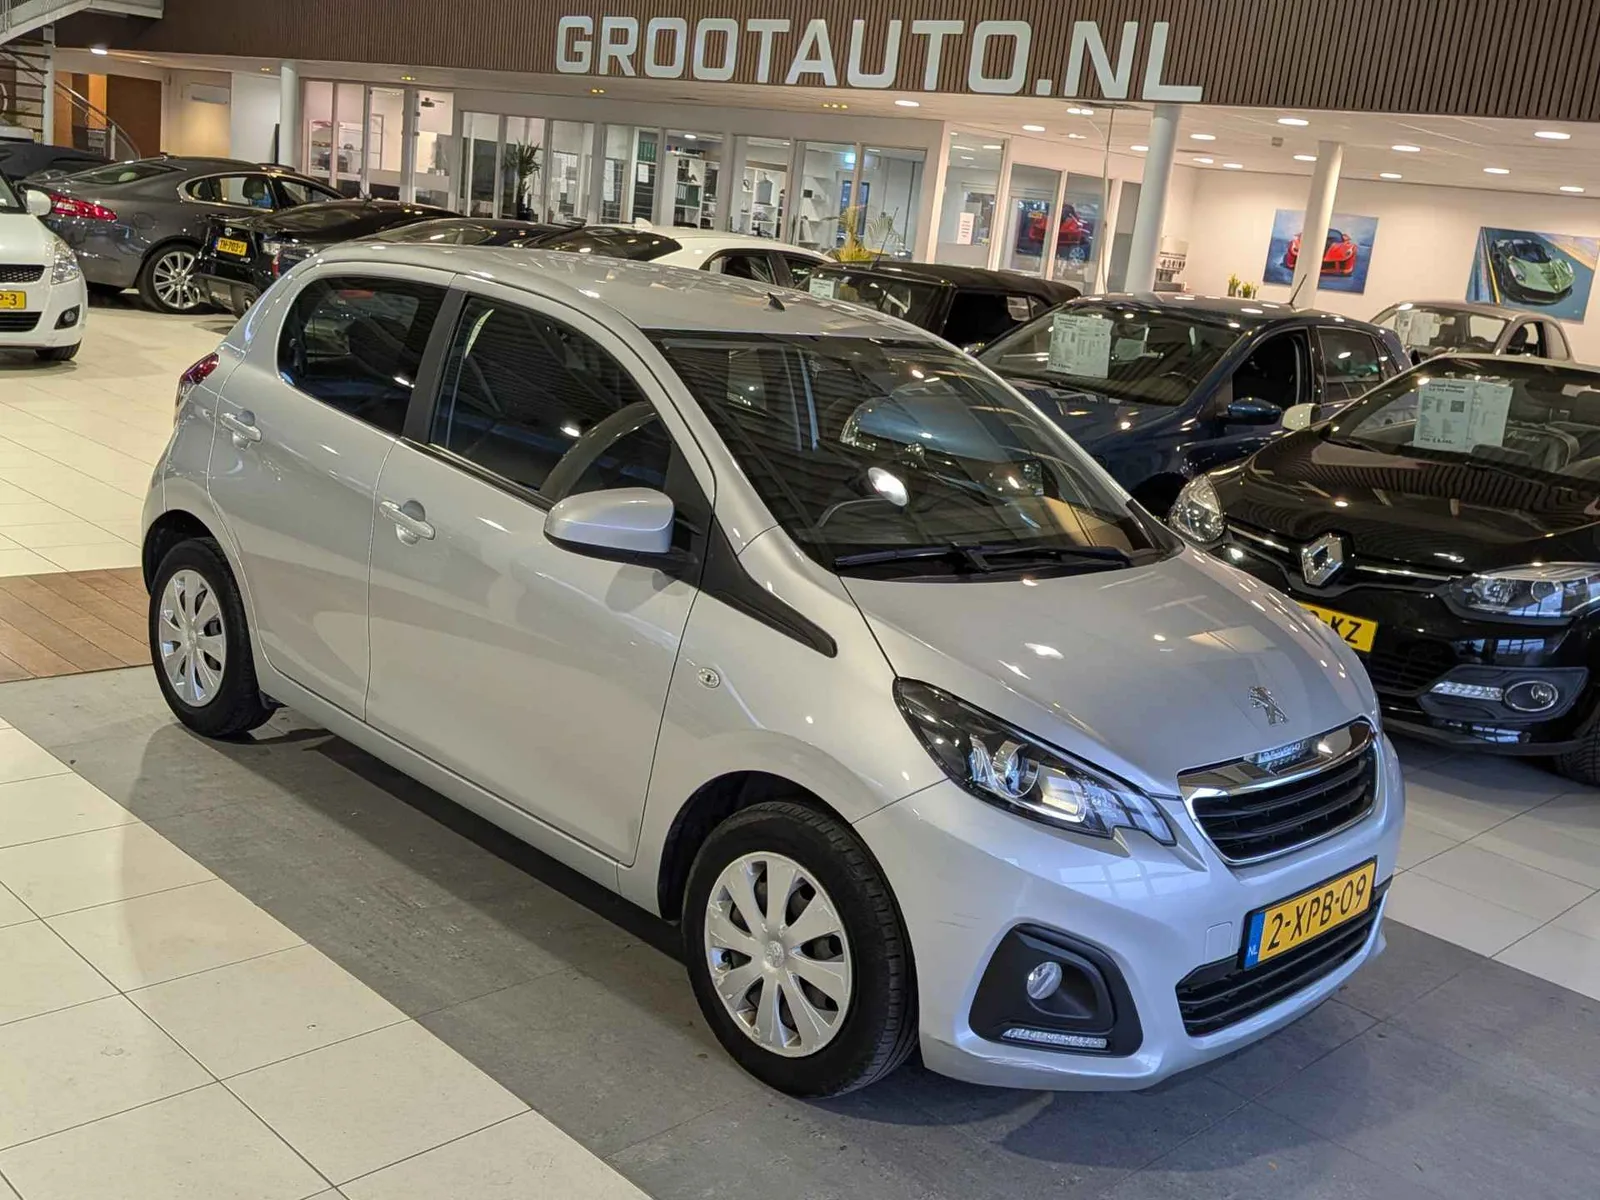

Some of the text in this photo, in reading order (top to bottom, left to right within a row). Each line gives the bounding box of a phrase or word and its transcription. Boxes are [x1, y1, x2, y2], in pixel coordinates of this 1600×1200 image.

[556, 15, 1203, 102] GROOTAUTO.NL
[1248, 945, 1258, 955] NL
[1267, 873, 1367, 951] 2-XPB-09
